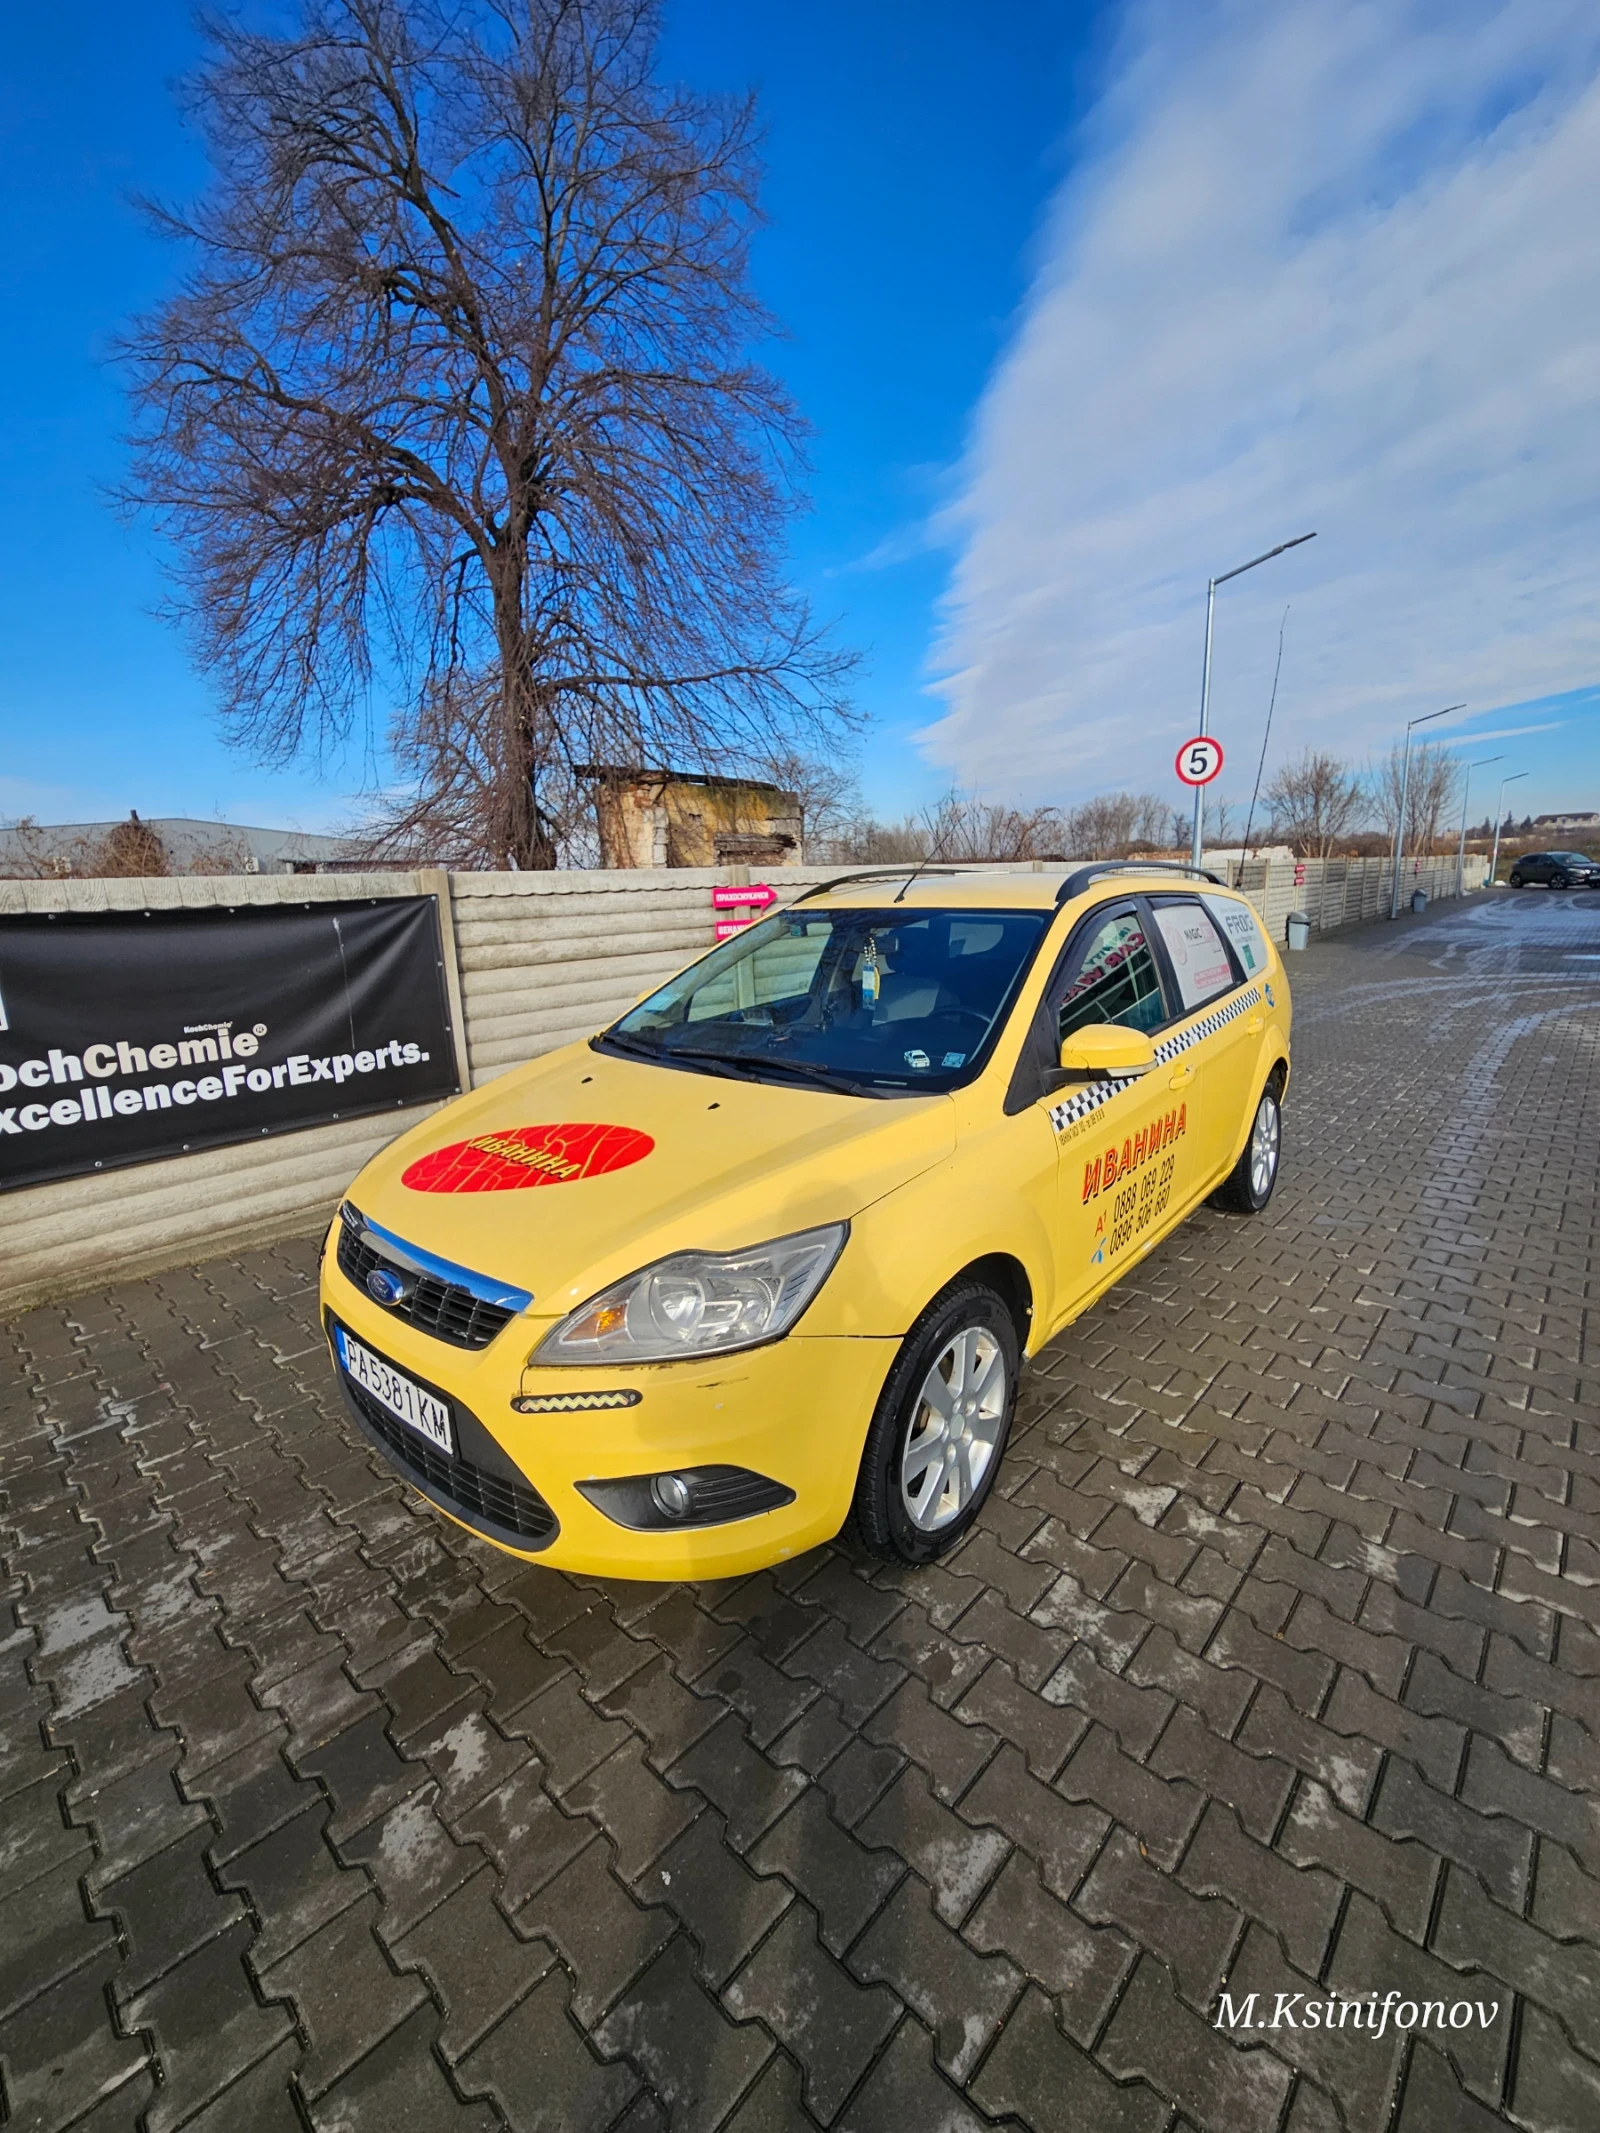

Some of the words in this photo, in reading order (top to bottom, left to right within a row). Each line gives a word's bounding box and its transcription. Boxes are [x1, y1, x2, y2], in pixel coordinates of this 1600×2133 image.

[1189, 746, 1208, 775] 5
[468, 1136, 582, 1181] ИВАНИНА
[1082, 1102, 1186, 1205] ИВАНИНА
[1114, 1182, 1137, 1223] 0888
[1141, 1167, 1157, 1202] 069
[1159, 1153, 1175, 1187] 229
[1110, 1214, 1134, 1256] 0896
[1136, 1198, 1153, 1234] 506
[346, 1339, 448, 1446] PA5381KM
